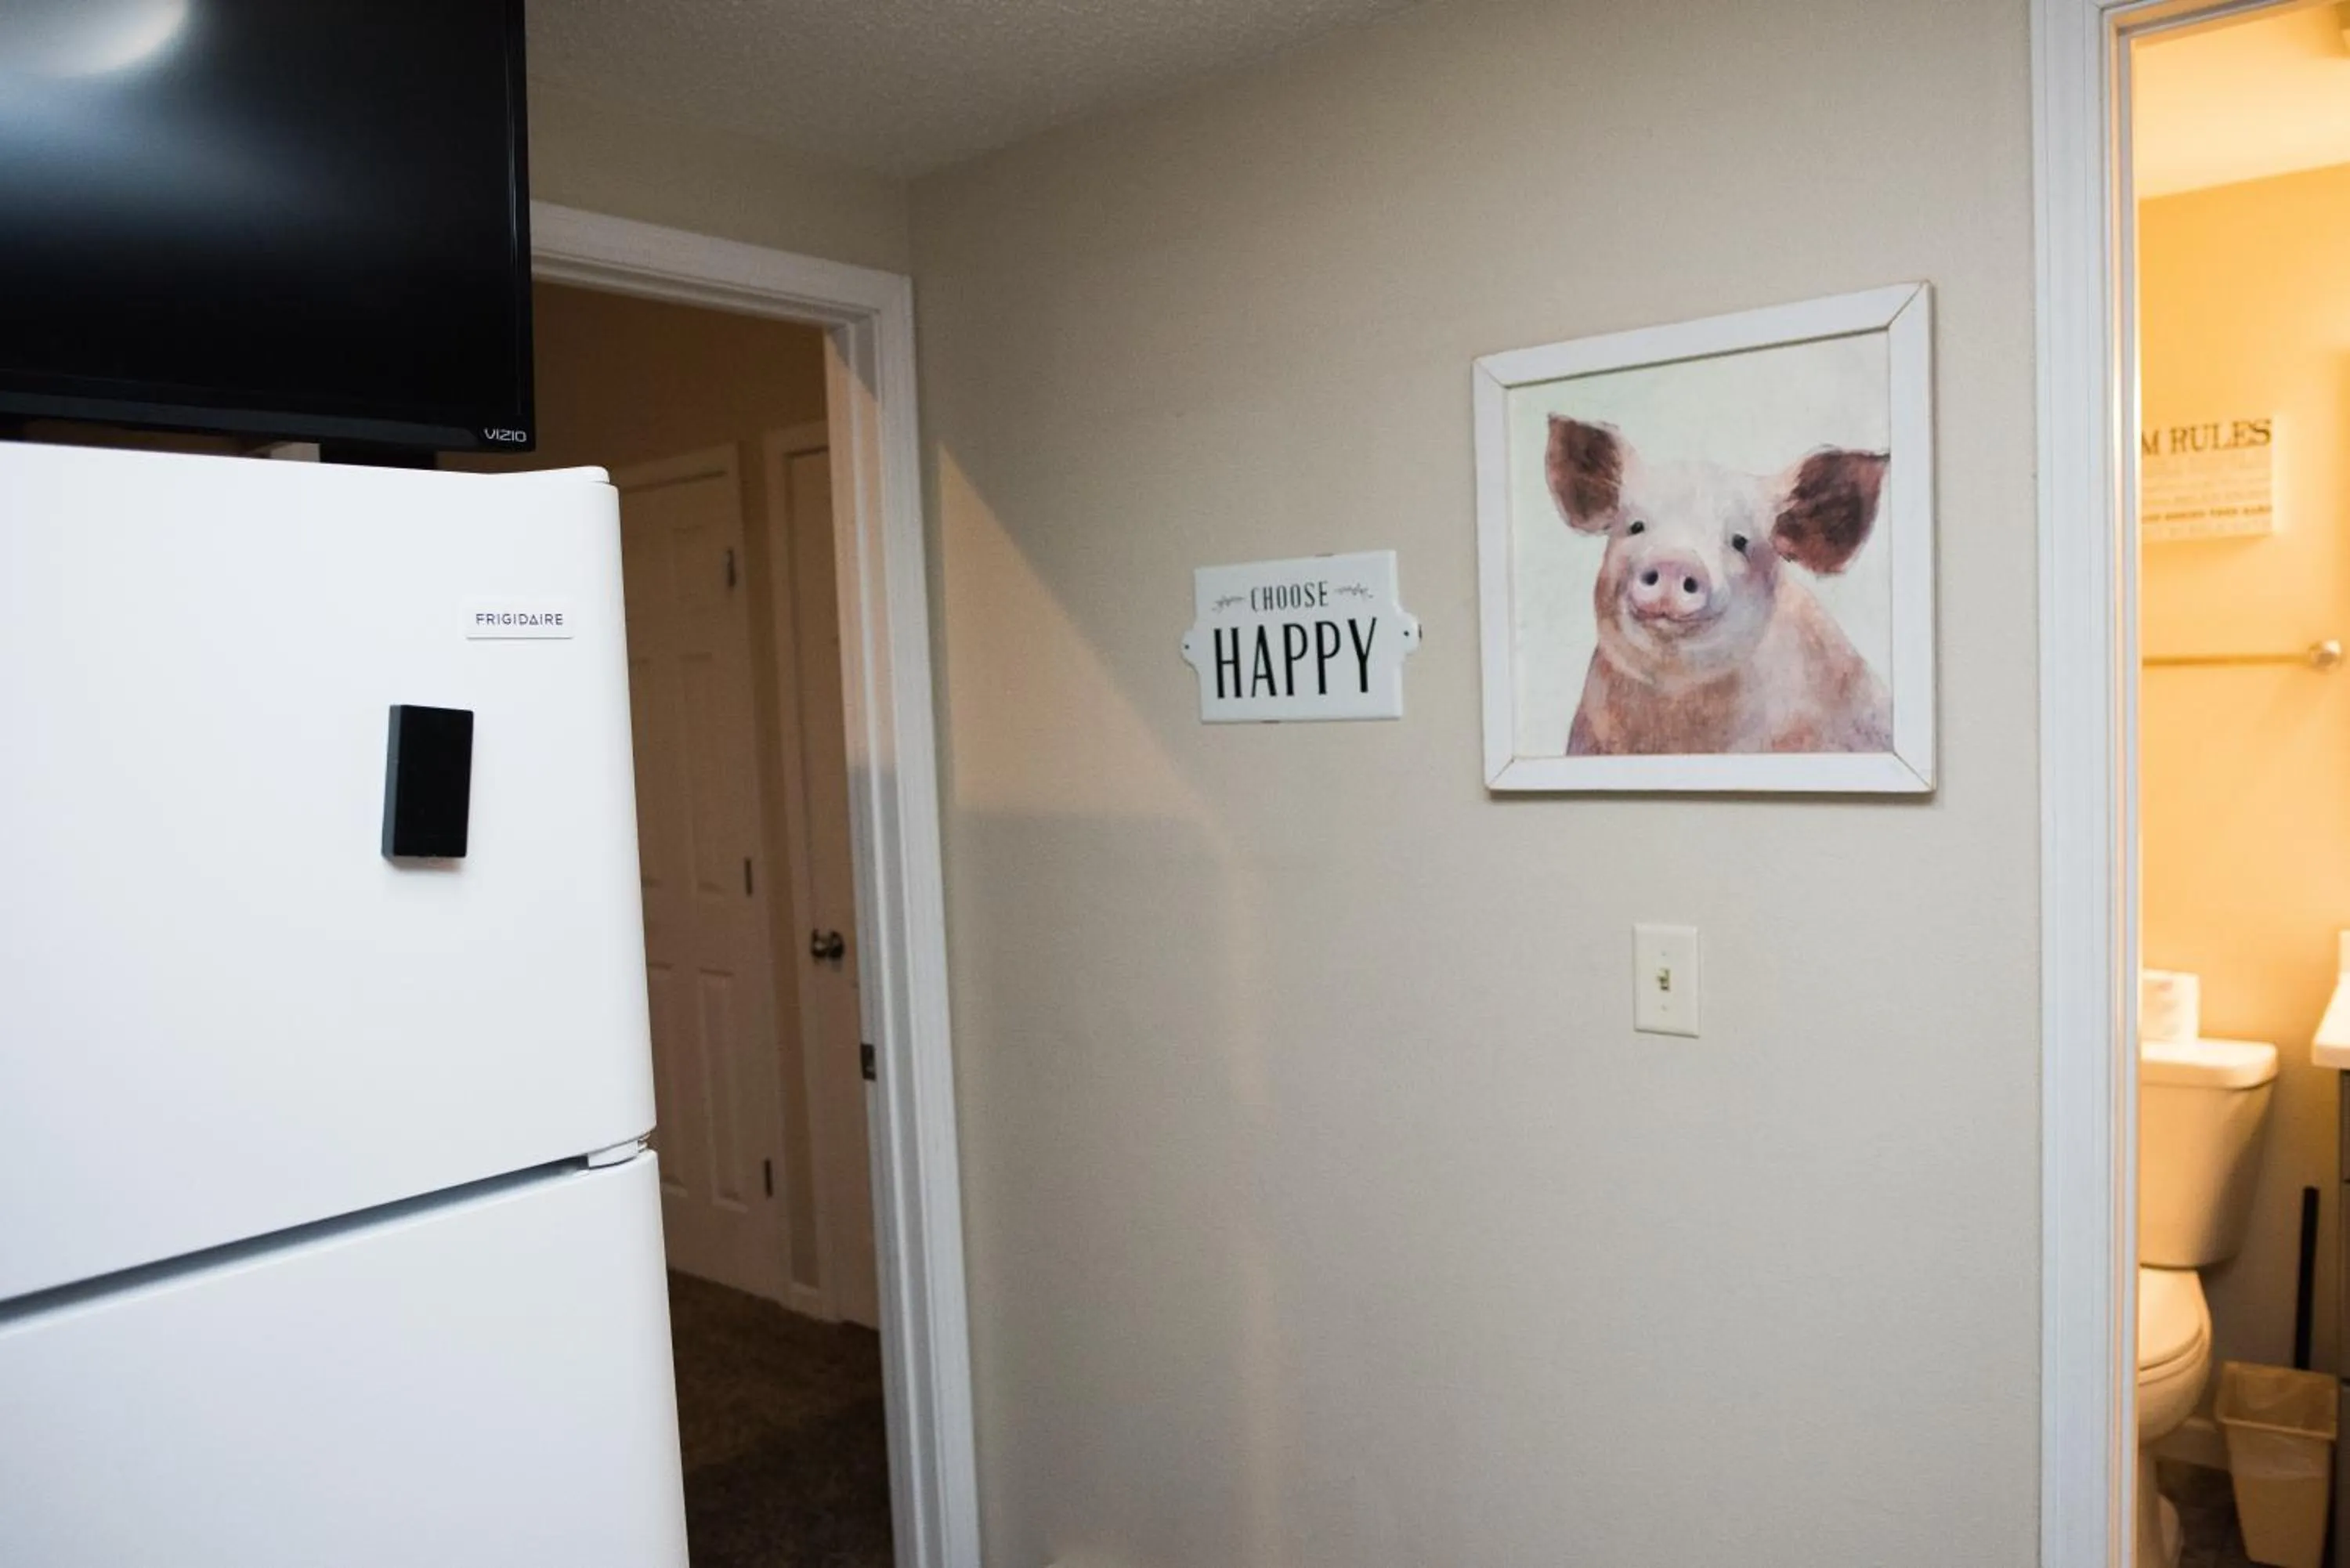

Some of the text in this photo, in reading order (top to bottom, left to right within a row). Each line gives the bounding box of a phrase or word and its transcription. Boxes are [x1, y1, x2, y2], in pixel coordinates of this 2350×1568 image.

[483, 428, 527, 443] VIZIO
[2170, 419, 2272, 455] RULES
[1250, 580, 1329, 612] CHOOSE
[475, 613, 563, 625] FRIGIDAIRE
[1213, 616, 1377, 699] HAPPY
